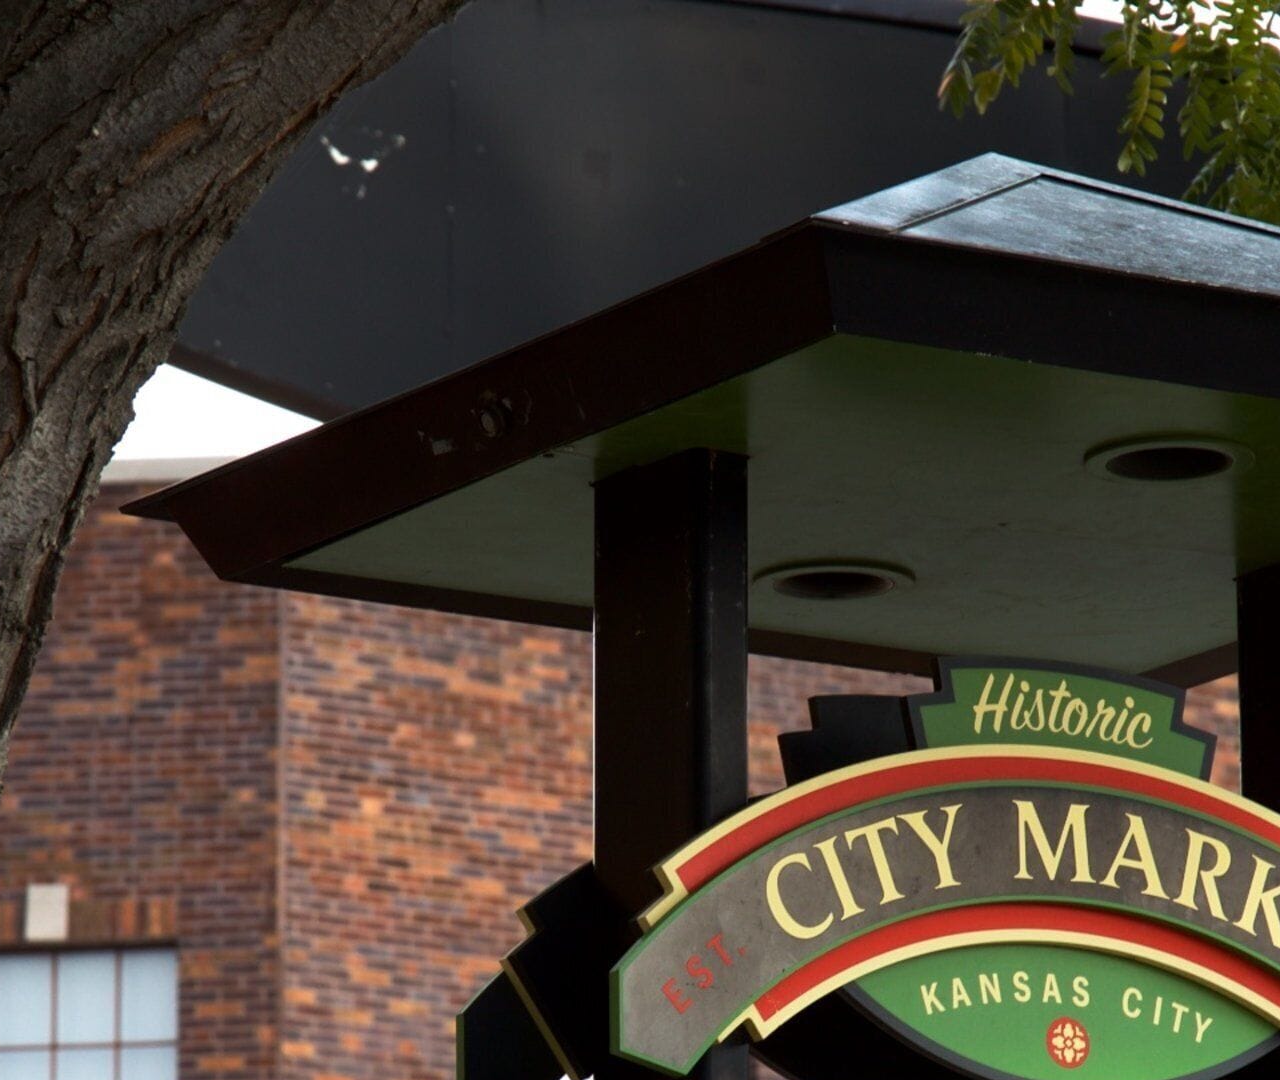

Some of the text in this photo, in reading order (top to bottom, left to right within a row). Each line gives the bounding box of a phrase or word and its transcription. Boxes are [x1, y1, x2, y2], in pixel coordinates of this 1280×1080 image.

[971, 671, 1154, 750] Historic
[764, 802, 963, 941] CITY
[920, 969, 1215, 1045] KANSAS CITY
